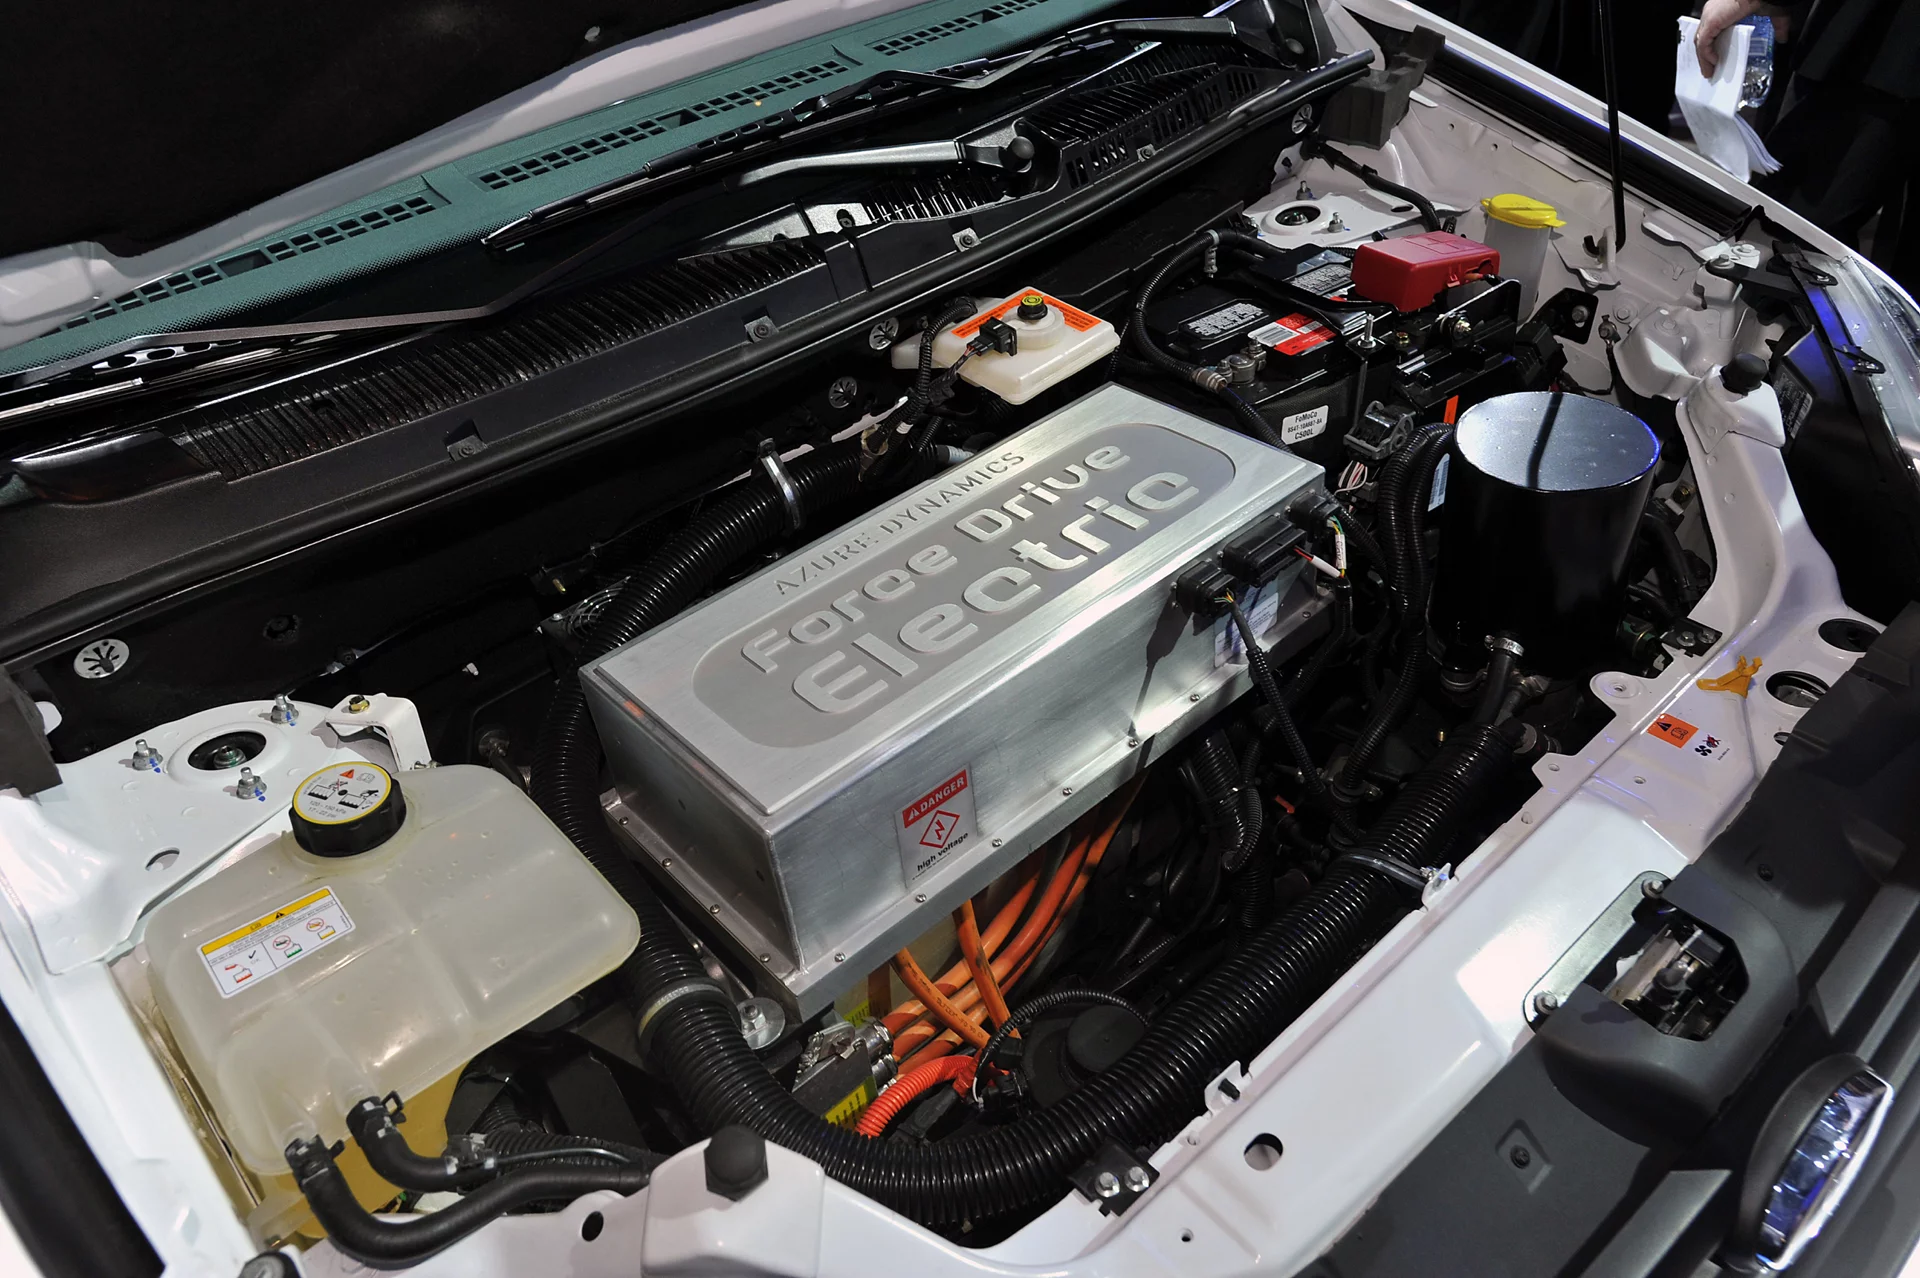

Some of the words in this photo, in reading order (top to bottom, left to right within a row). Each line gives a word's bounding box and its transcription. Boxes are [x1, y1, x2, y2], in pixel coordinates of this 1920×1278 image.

[1295, 411, 1318, 423] FoMoCo
[740, 544, 958, 674] Force
[954, 445, 1131, 543] Drive
[773, 532, 879, 595] AZURE
[879, 451, 1025, 534] DYNAMICS
[791, 471, 1200, 714] Electric
[919, 776, 965, 813] DANGER
[916, 855, 937, 872] high
[937, 832, 969, 857] voltage
